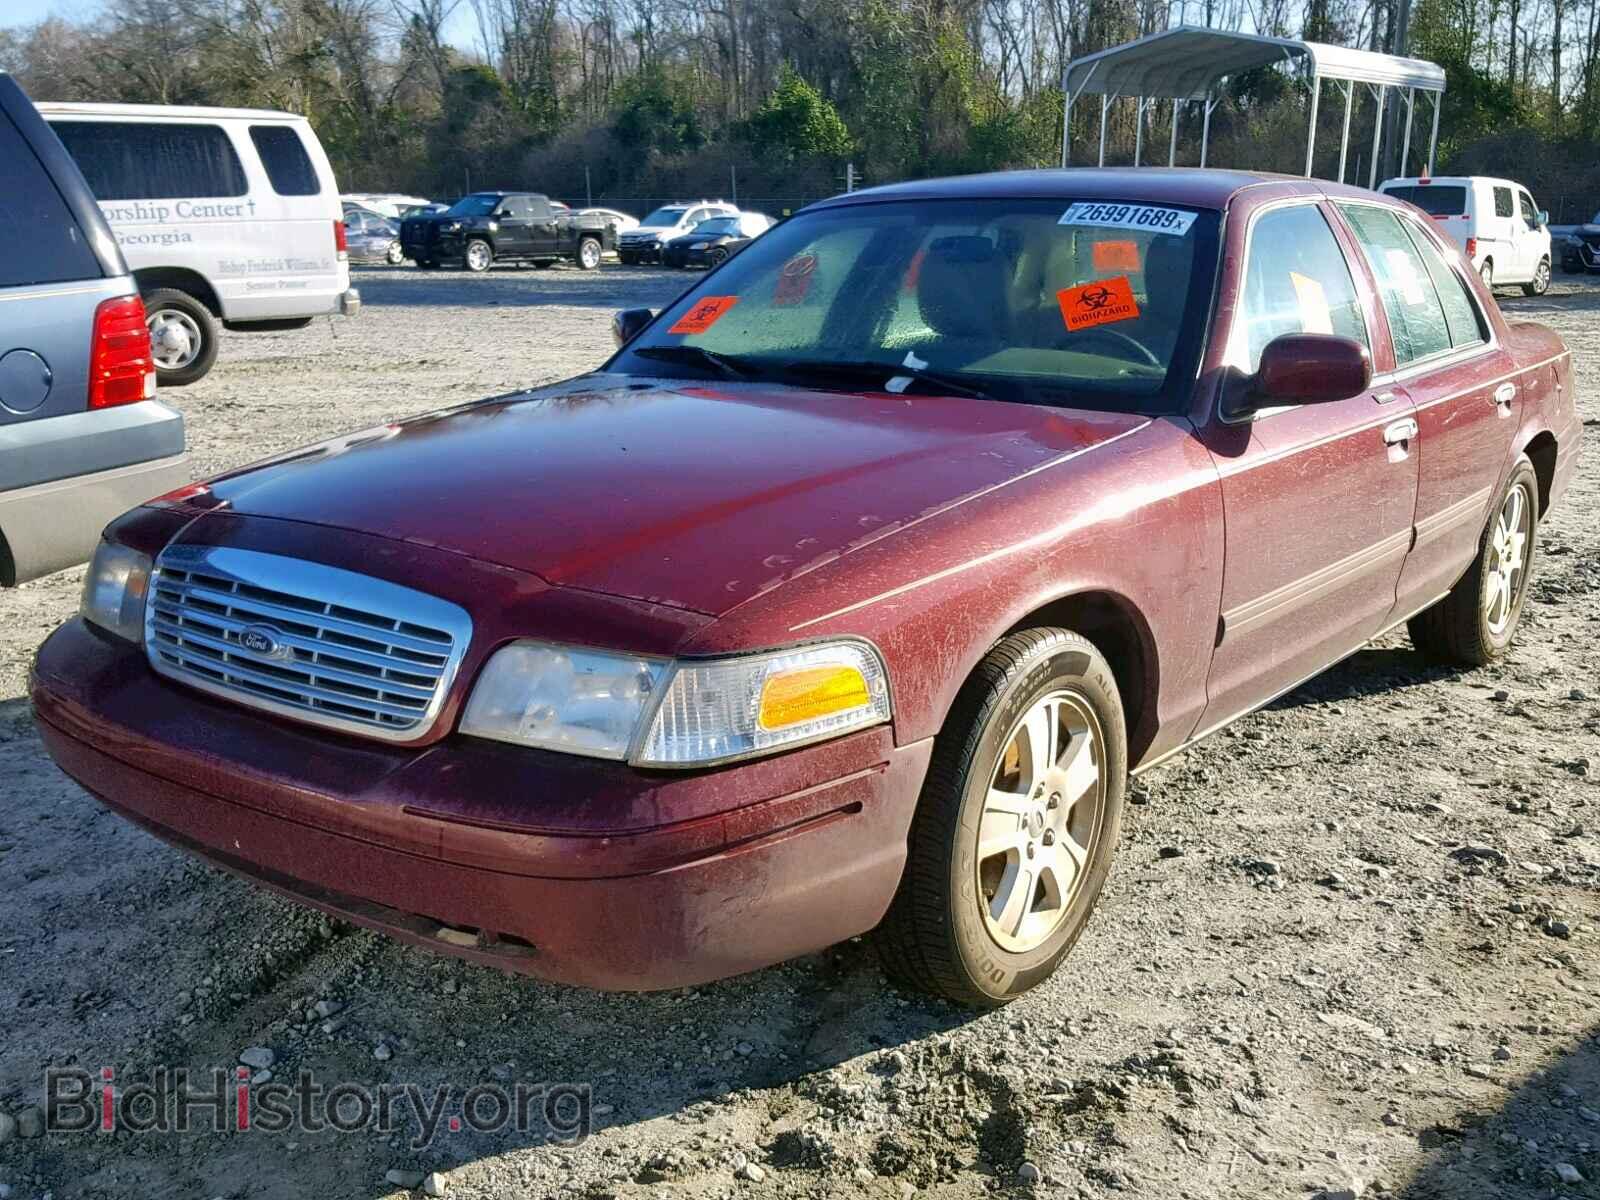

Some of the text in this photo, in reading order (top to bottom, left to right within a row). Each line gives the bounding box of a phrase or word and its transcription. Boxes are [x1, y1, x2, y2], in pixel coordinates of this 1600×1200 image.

[104, 200, 243, 223] orship Center
[1071, 304, 1130, 324] BIOHAZARD
